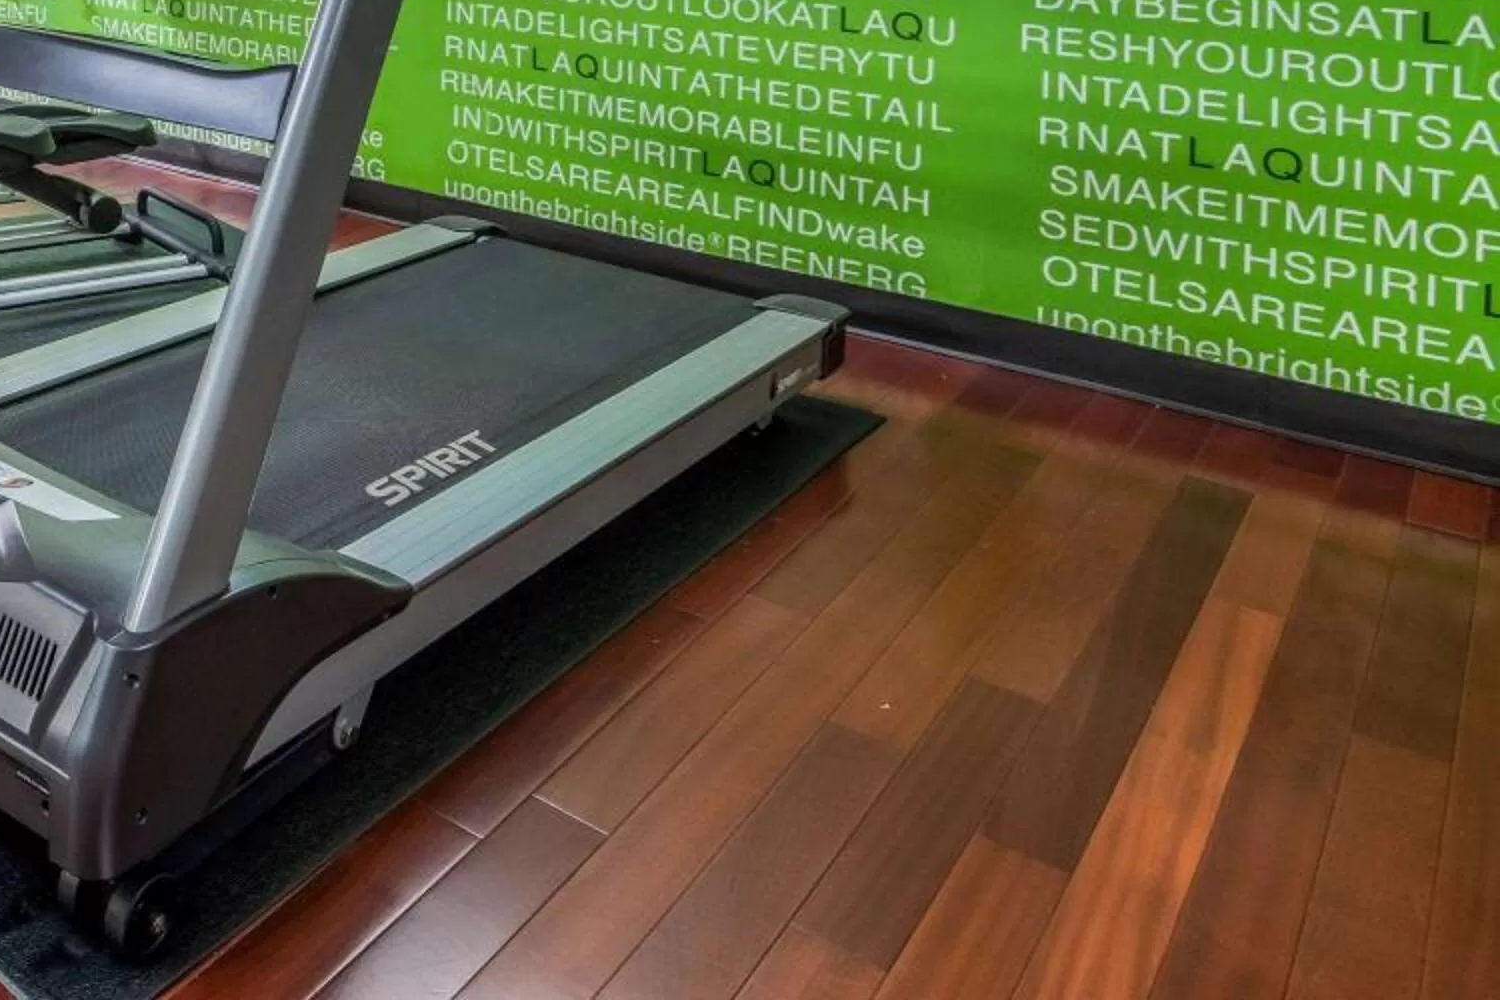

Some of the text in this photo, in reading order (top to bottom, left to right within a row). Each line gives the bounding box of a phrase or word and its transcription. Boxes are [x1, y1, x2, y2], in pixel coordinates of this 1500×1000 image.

[445, 35, 954, 133] RNATLAQUINTATHEDETAIL
[446, 0, 936, 86] INTADELIGHTSATEVERYTU
[1041, 69, 1500, 156] INTADELIGHTSA
[447, 140, 925, 259] OTELSAREAREALFINDwake
[1039, 116, 1500, 211] RNATLAQUINTA
[1042, 256, 1497, 372] OTELSAREAREA
[364, 429, 497, 508] SPIRIT
